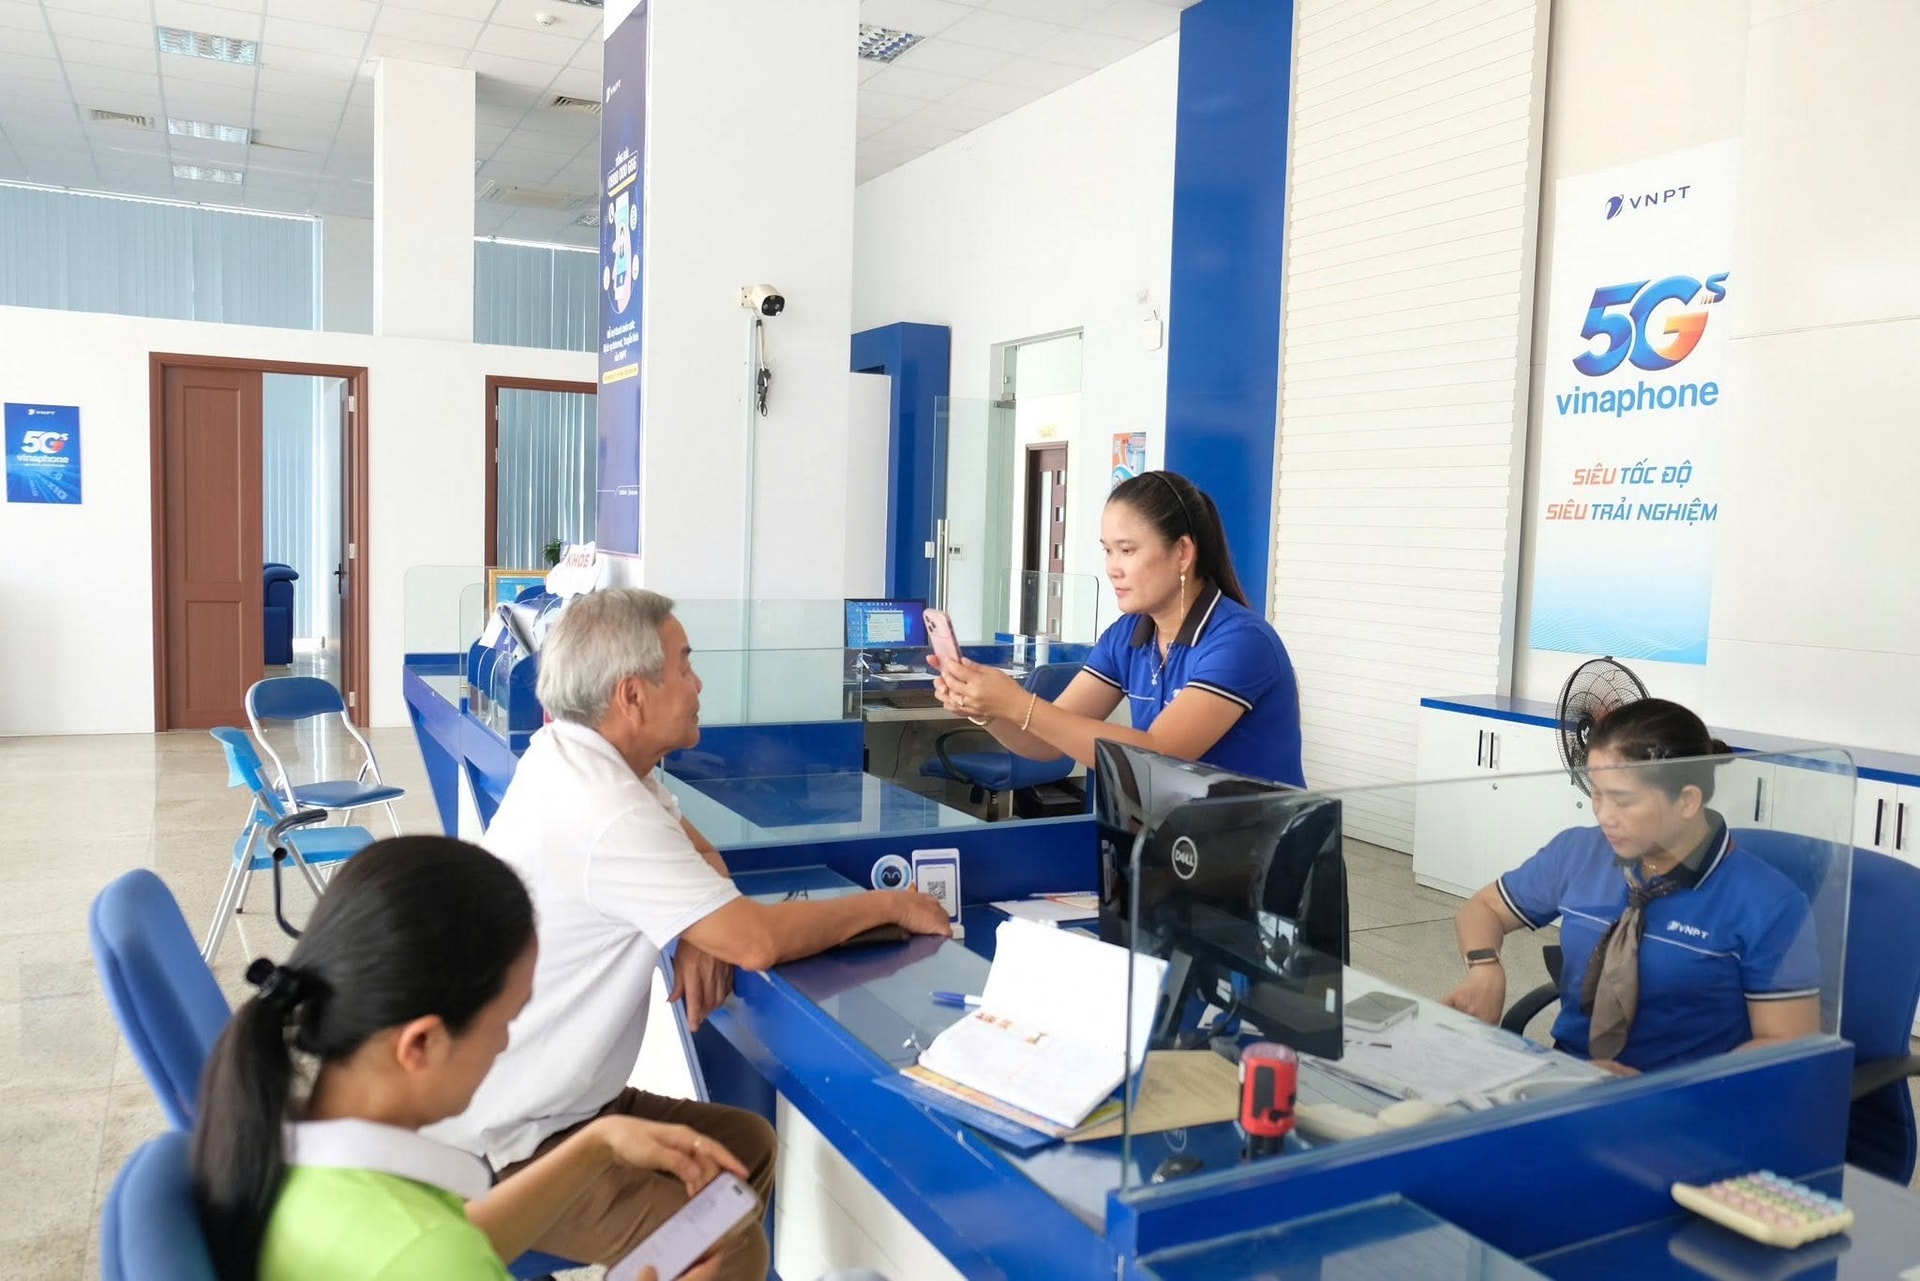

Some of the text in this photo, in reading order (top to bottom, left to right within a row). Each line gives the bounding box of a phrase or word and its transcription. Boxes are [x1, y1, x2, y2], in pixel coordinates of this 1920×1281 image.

[1629, 185, 1691, 209] VNPT
[1556, 380, 1719, 418] vinaphone
[1572, 457, 1693, 488] SIÊU TỐC ĐỘ
[1546, 495, 1718, 526] SIÊU TRẢI NGHIỆM
[1175, 850, 1194, 867] DELL
[1679, 923, 1709, 939] VNPT
